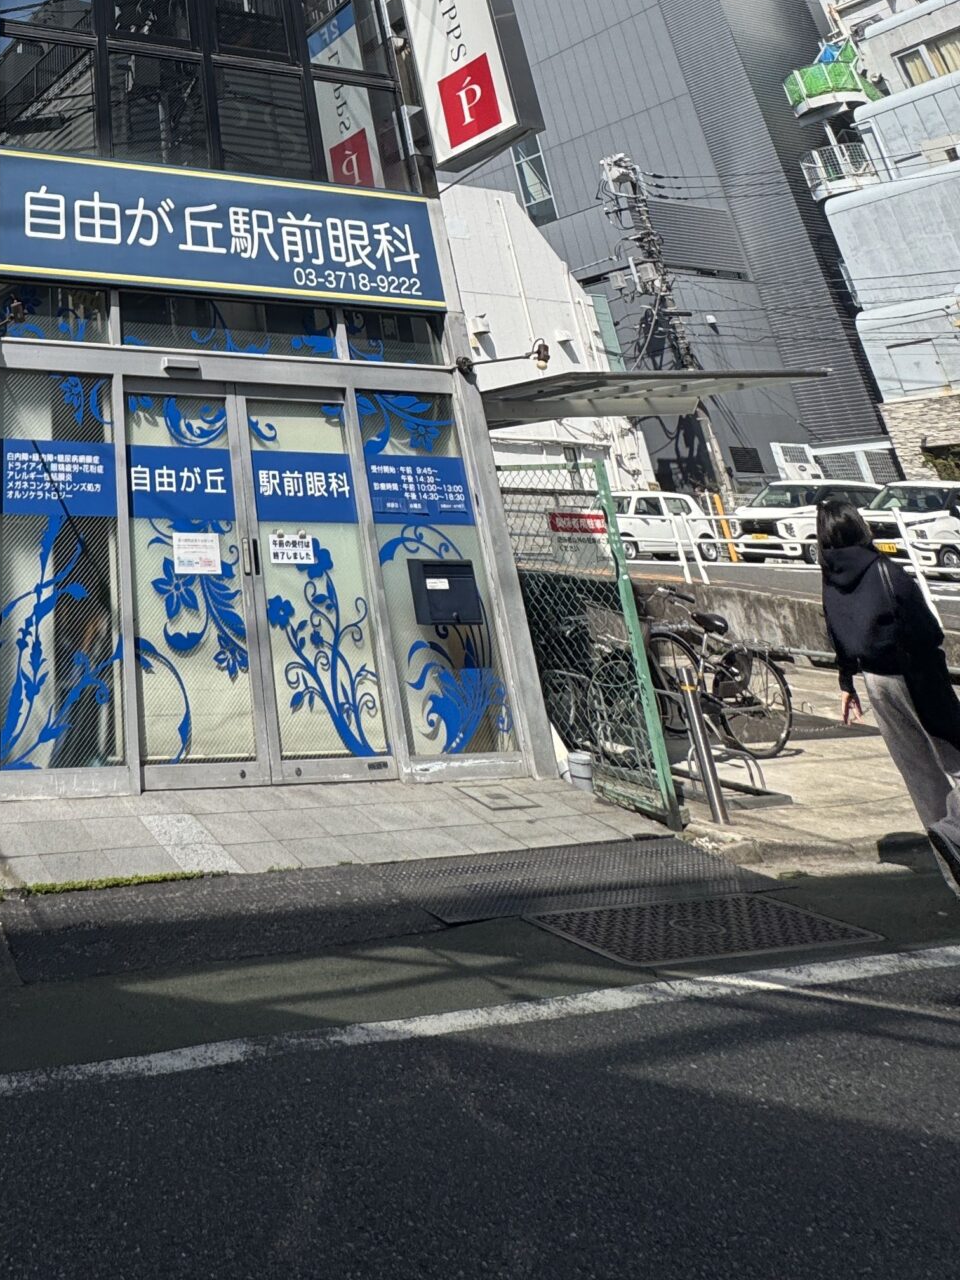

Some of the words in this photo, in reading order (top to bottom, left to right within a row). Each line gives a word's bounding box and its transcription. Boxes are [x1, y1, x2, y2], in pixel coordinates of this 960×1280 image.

[24, 185, 421, 274] 自由が丘駅前眼科
[293, 267, 423, 296] 03-3718-9222
[130, 465, 227, 494] 自由が丘
[258, 470, 350, 498] 駅前眼科
[272, 540, 310, 548] 午前の受付は
[273, 551, 312, 560] 終了しました
